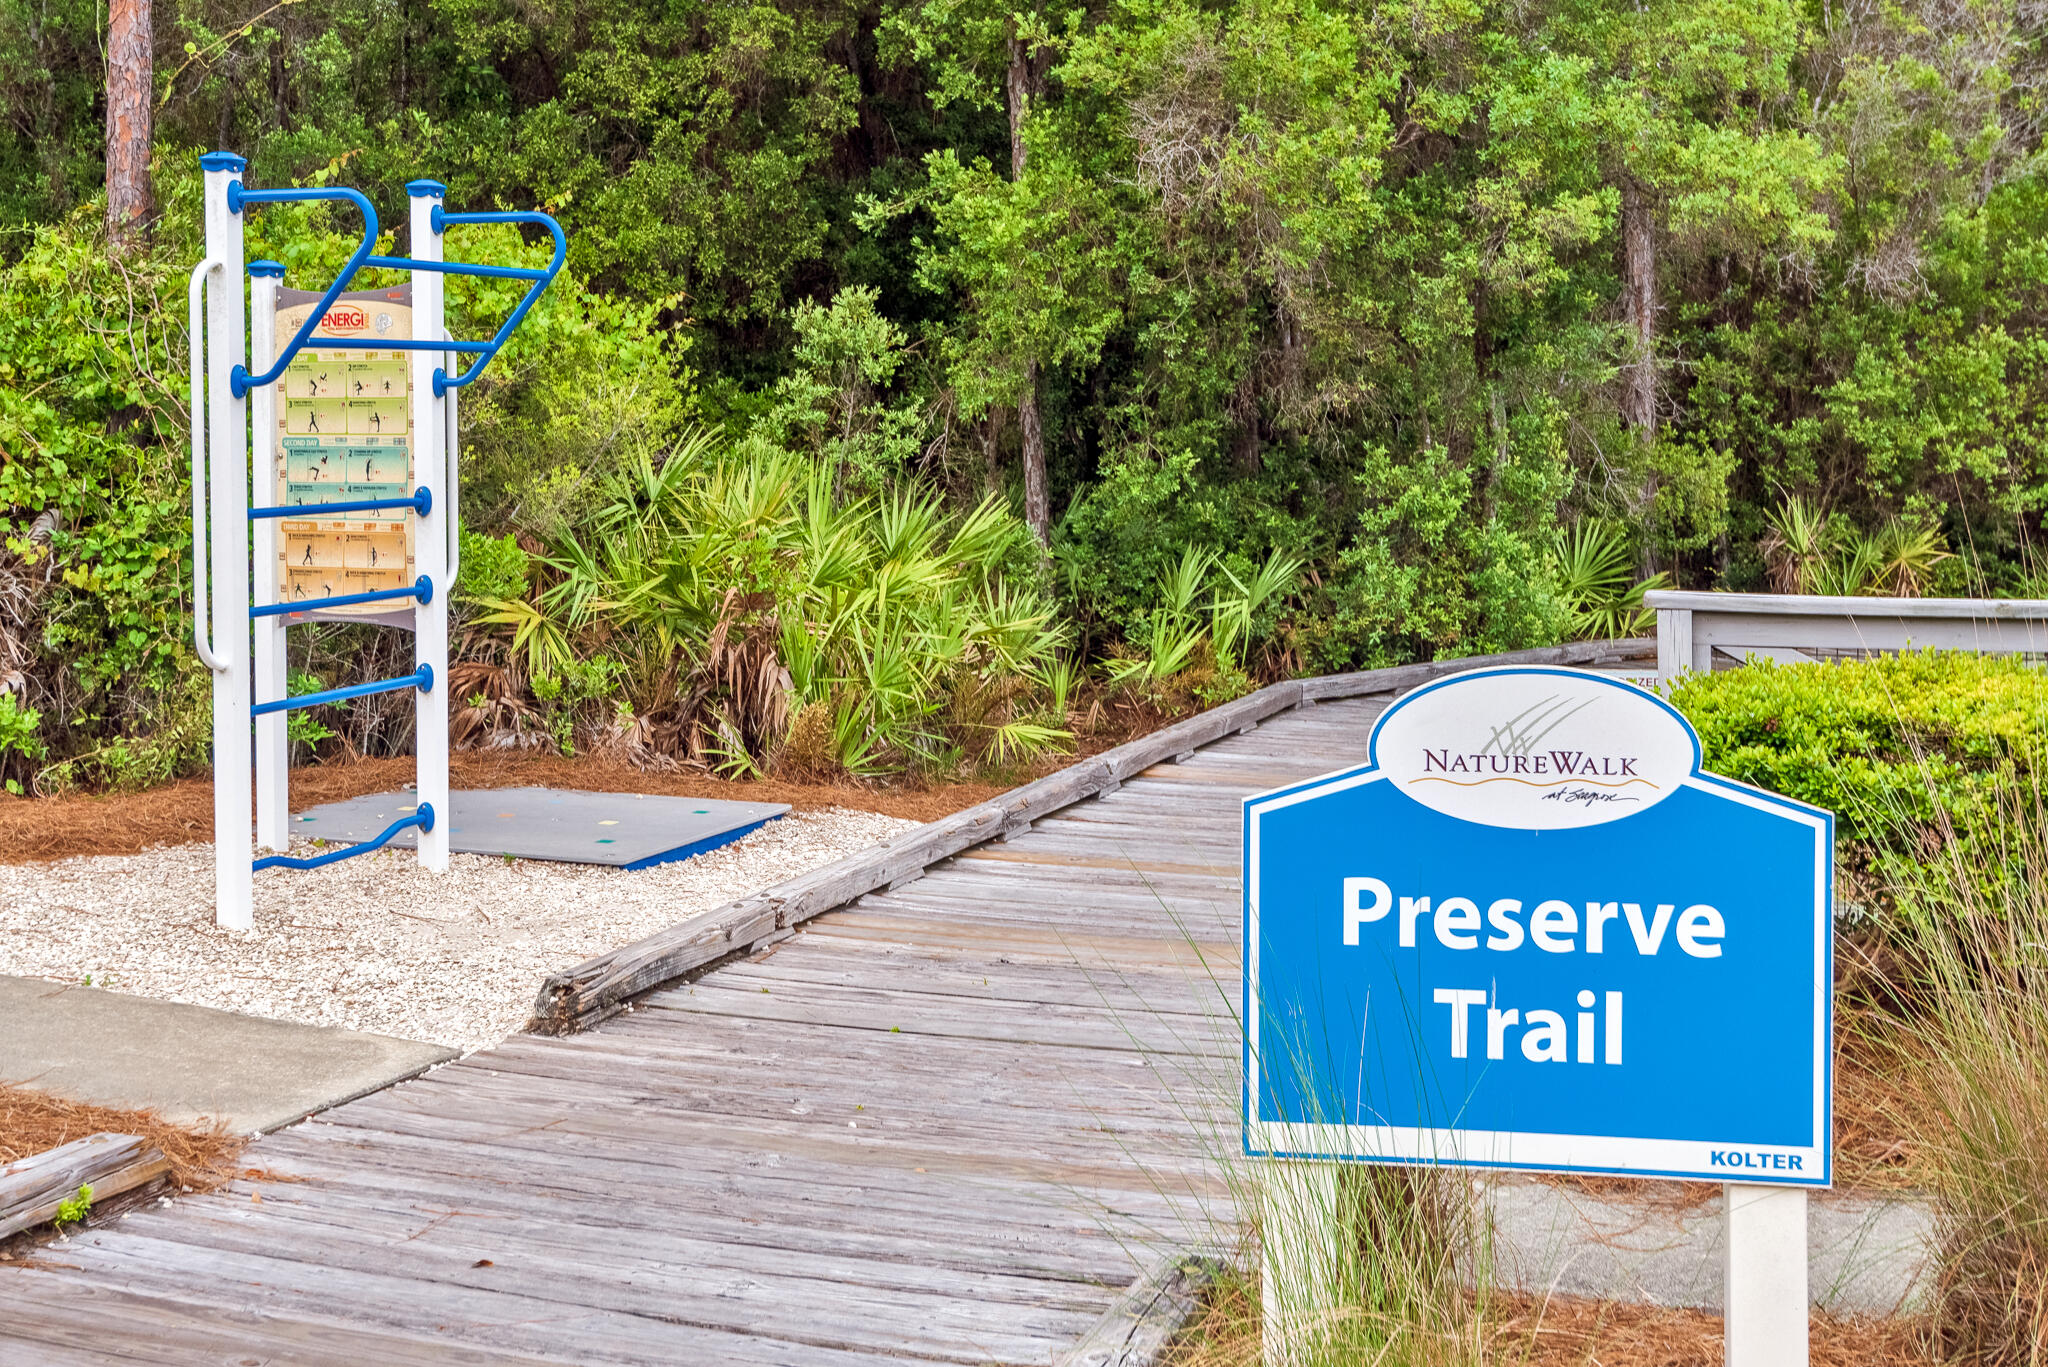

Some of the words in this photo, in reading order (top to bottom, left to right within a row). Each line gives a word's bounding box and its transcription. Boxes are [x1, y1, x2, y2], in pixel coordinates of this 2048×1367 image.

[321, 312, 364, 327] ENERGI
[283, 439, 306, 447] SECOND
[306, 439, 318, 447] DAY
[300, 523, 310, 531] DAY
[1422, 748, 1639, 776] NATUREWALK
[1541, 786, 1566, 800] at
[1342, 876, 1726, 959] Preserve
[1433, 987, 1623, 1066] Trail
[1710, 1150, 1804, 1171] KOLTER
